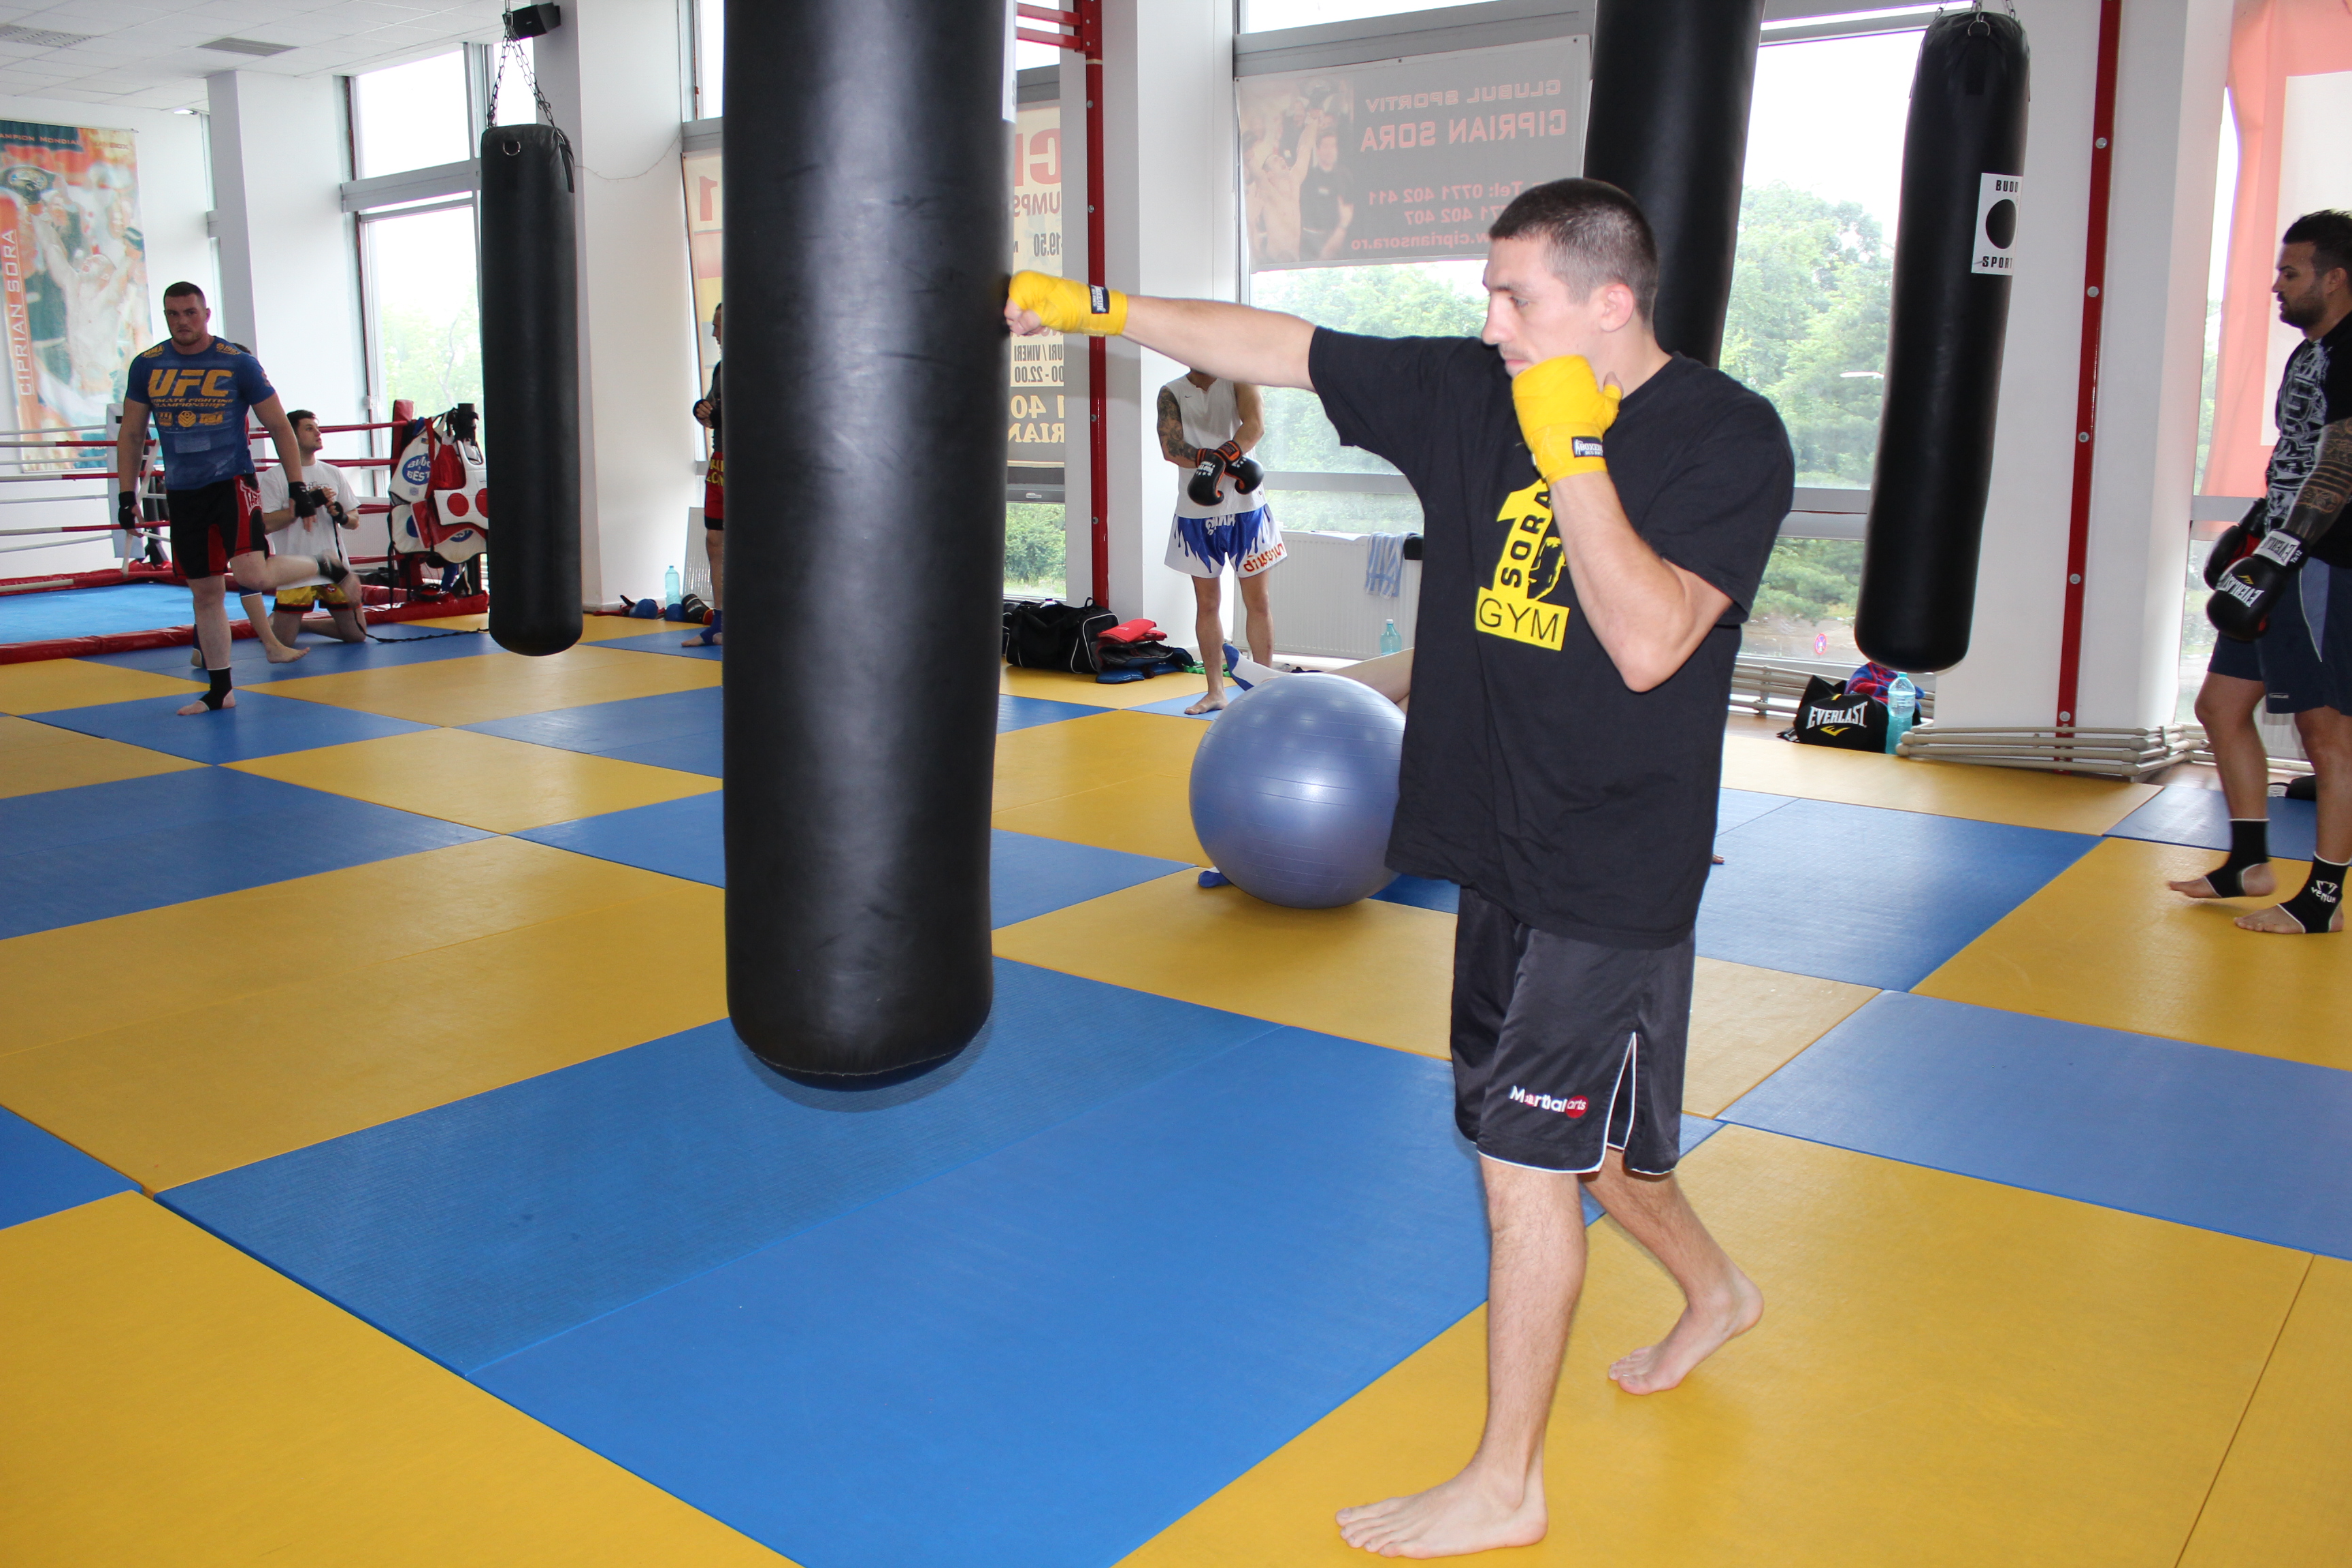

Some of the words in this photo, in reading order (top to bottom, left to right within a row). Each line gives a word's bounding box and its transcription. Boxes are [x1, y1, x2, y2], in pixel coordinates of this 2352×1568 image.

[2, 229, 20, 293] SORA
[10, 304, 33, 396] CIPRIAN
[148, 369, 233, 397] UFC
[1501, 491, 1552, 588] SORA
[1479, 598, 1560, 642] GYM
[1806, 701, 1868, 730] EVERLAST
[1509, 1085, 1568, 1113] Martial
[1567, 1098, 1587, 1111] arts
